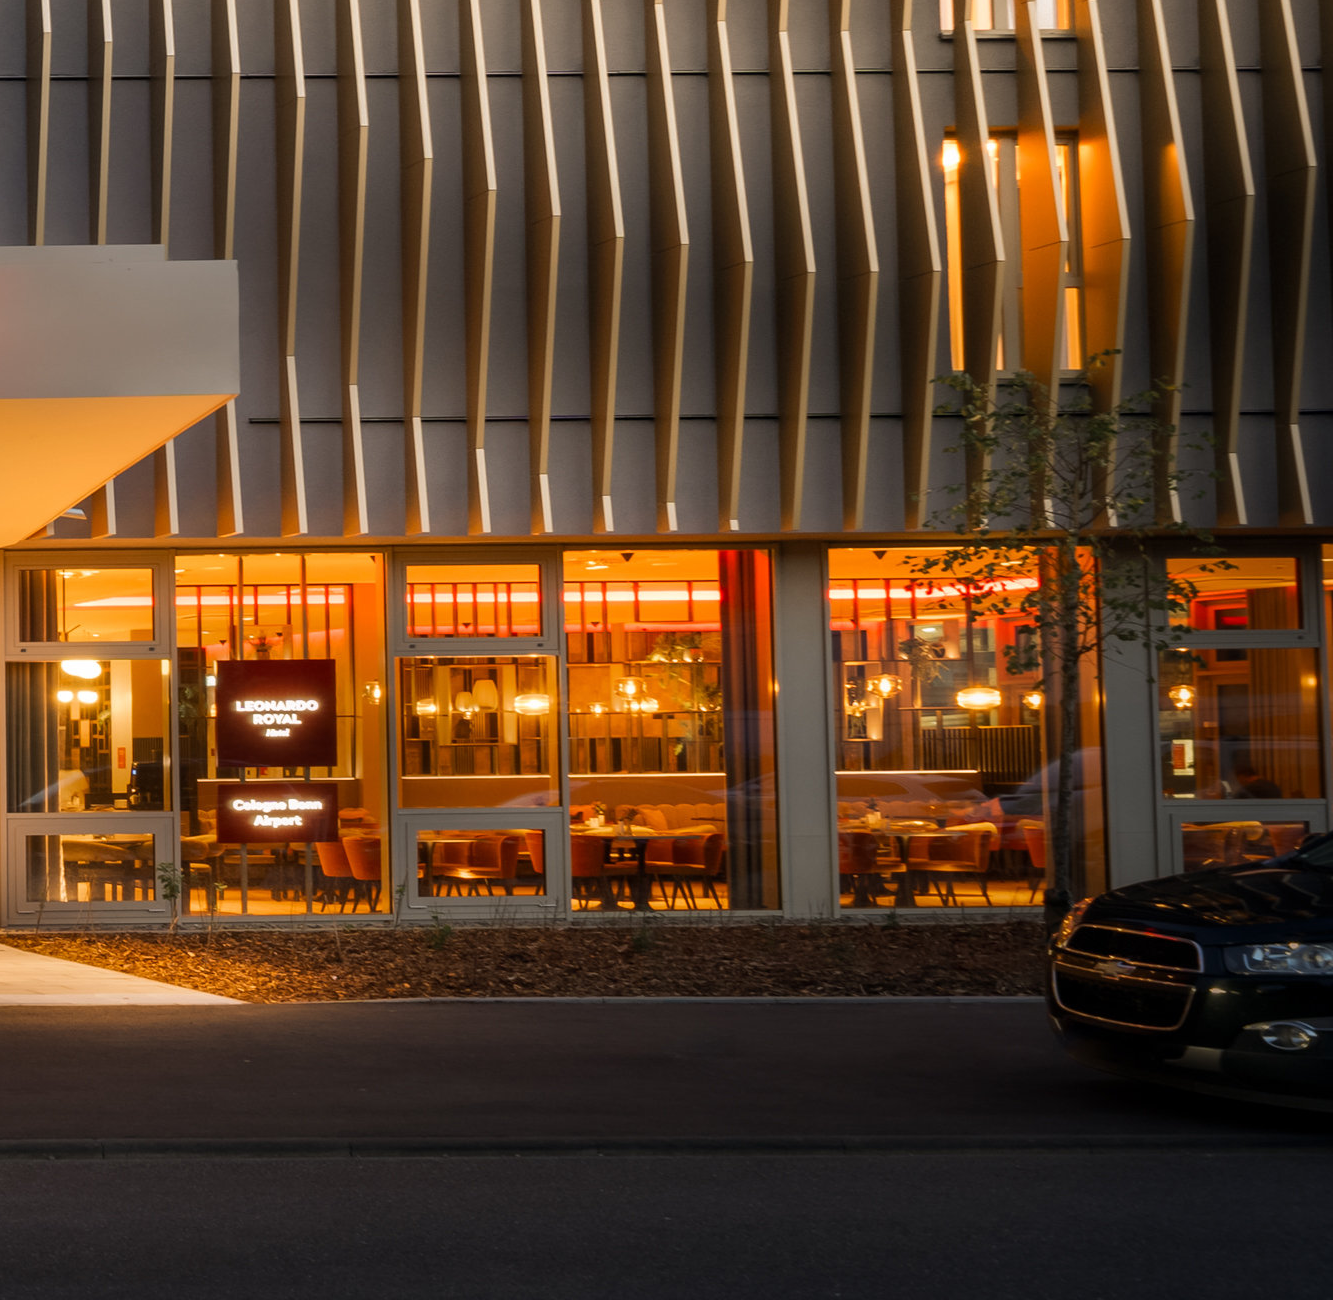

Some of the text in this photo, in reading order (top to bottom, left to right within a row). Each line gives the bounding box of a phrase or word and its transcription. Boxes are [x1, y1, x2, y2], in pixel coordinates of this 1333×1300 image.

[235, 700, 319, 712] LEONARDO
[252, 713, 303, 725] ROYAL
[232, 798, 287, 813] Cologne
[253, 814, 303, 828] Airport
